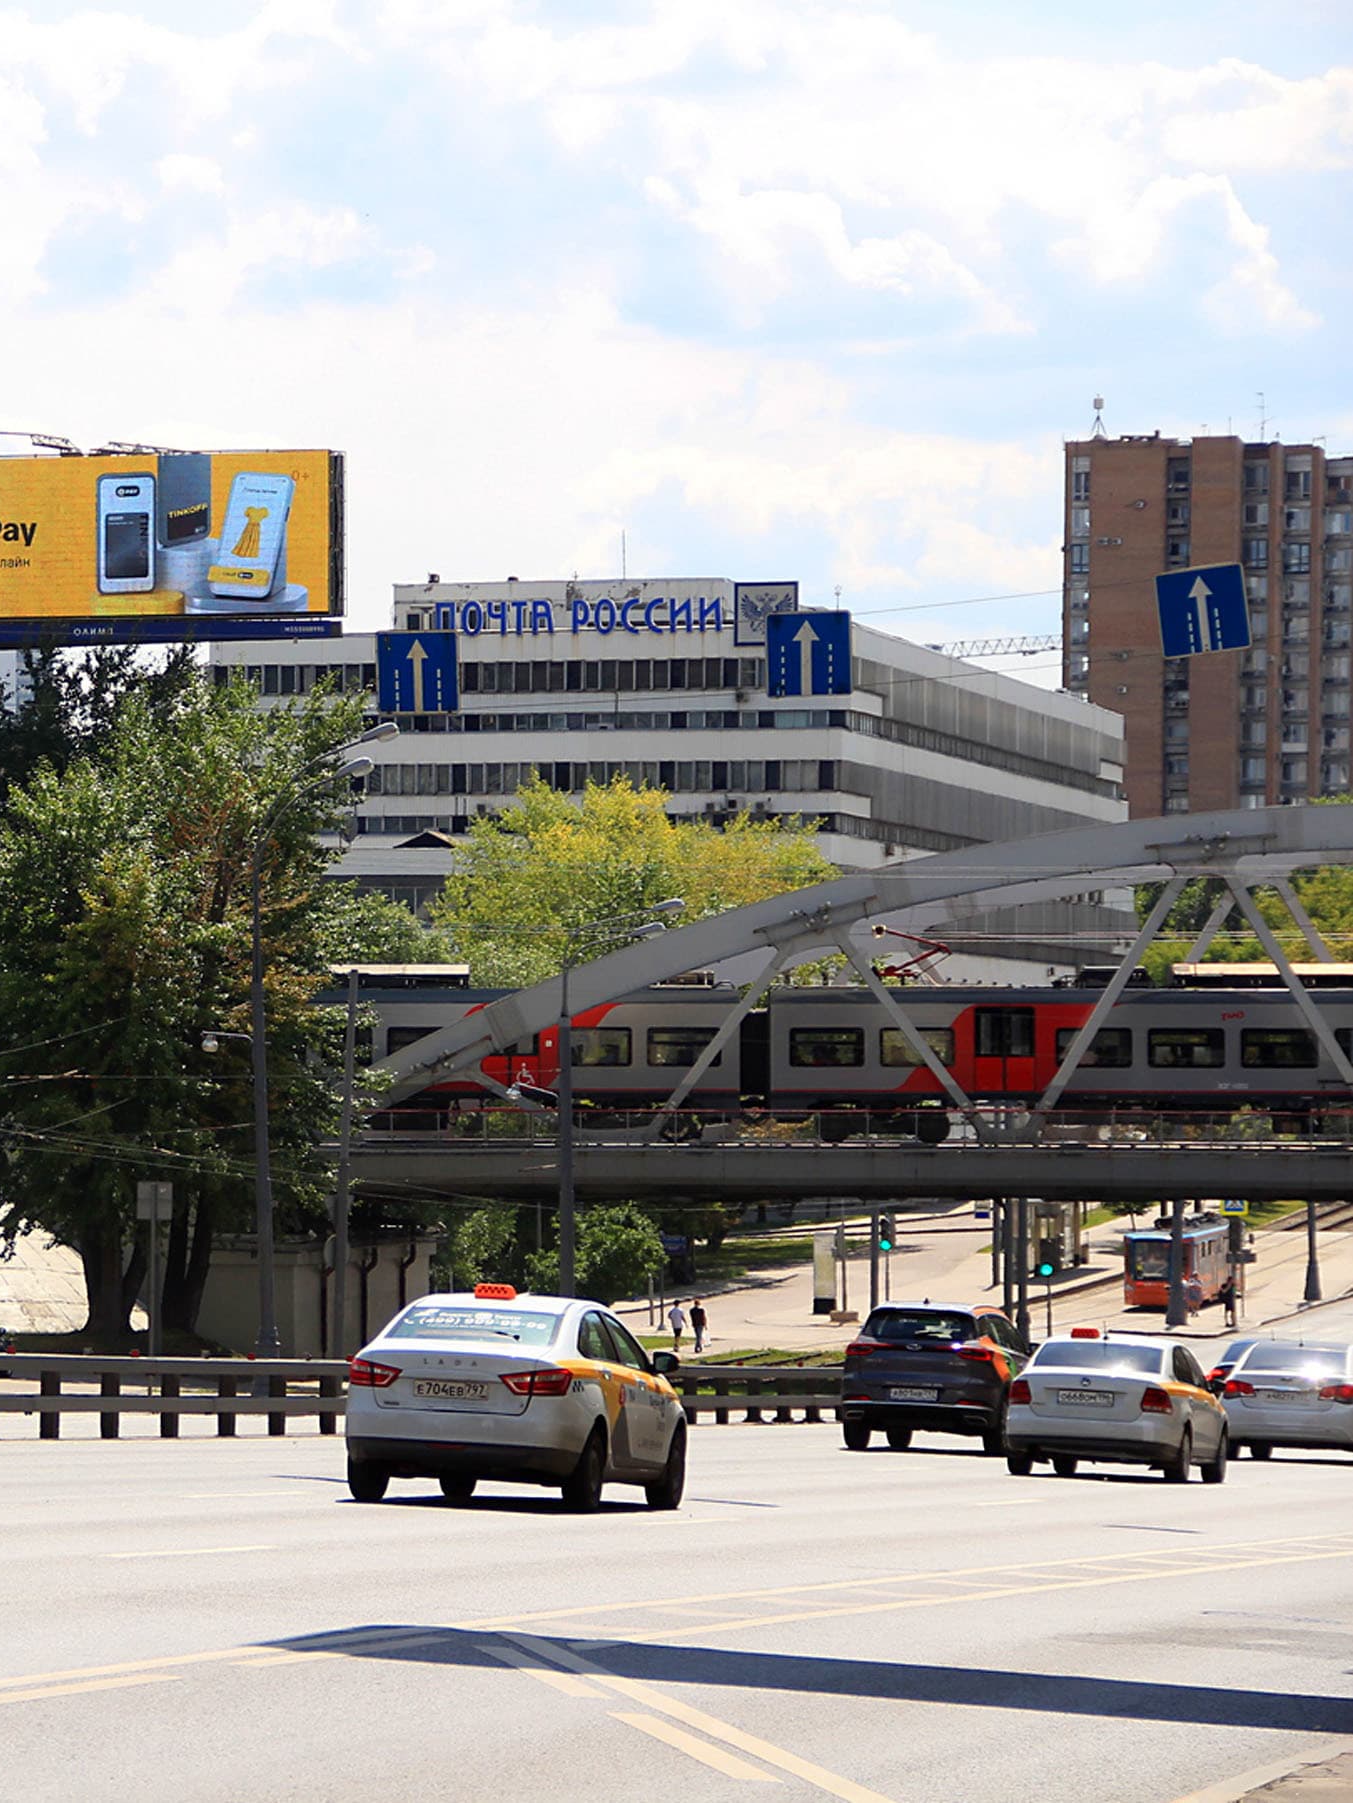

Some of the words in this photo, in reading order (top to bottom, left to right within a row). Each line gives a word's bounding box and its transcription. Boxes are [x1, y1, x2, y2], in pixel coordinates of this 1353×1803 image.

[435, 599, 554, 636] ПОЧТА
[571, 597, 724, 635] РОССИИ
[423, 1358, 478, 1367] LADA
